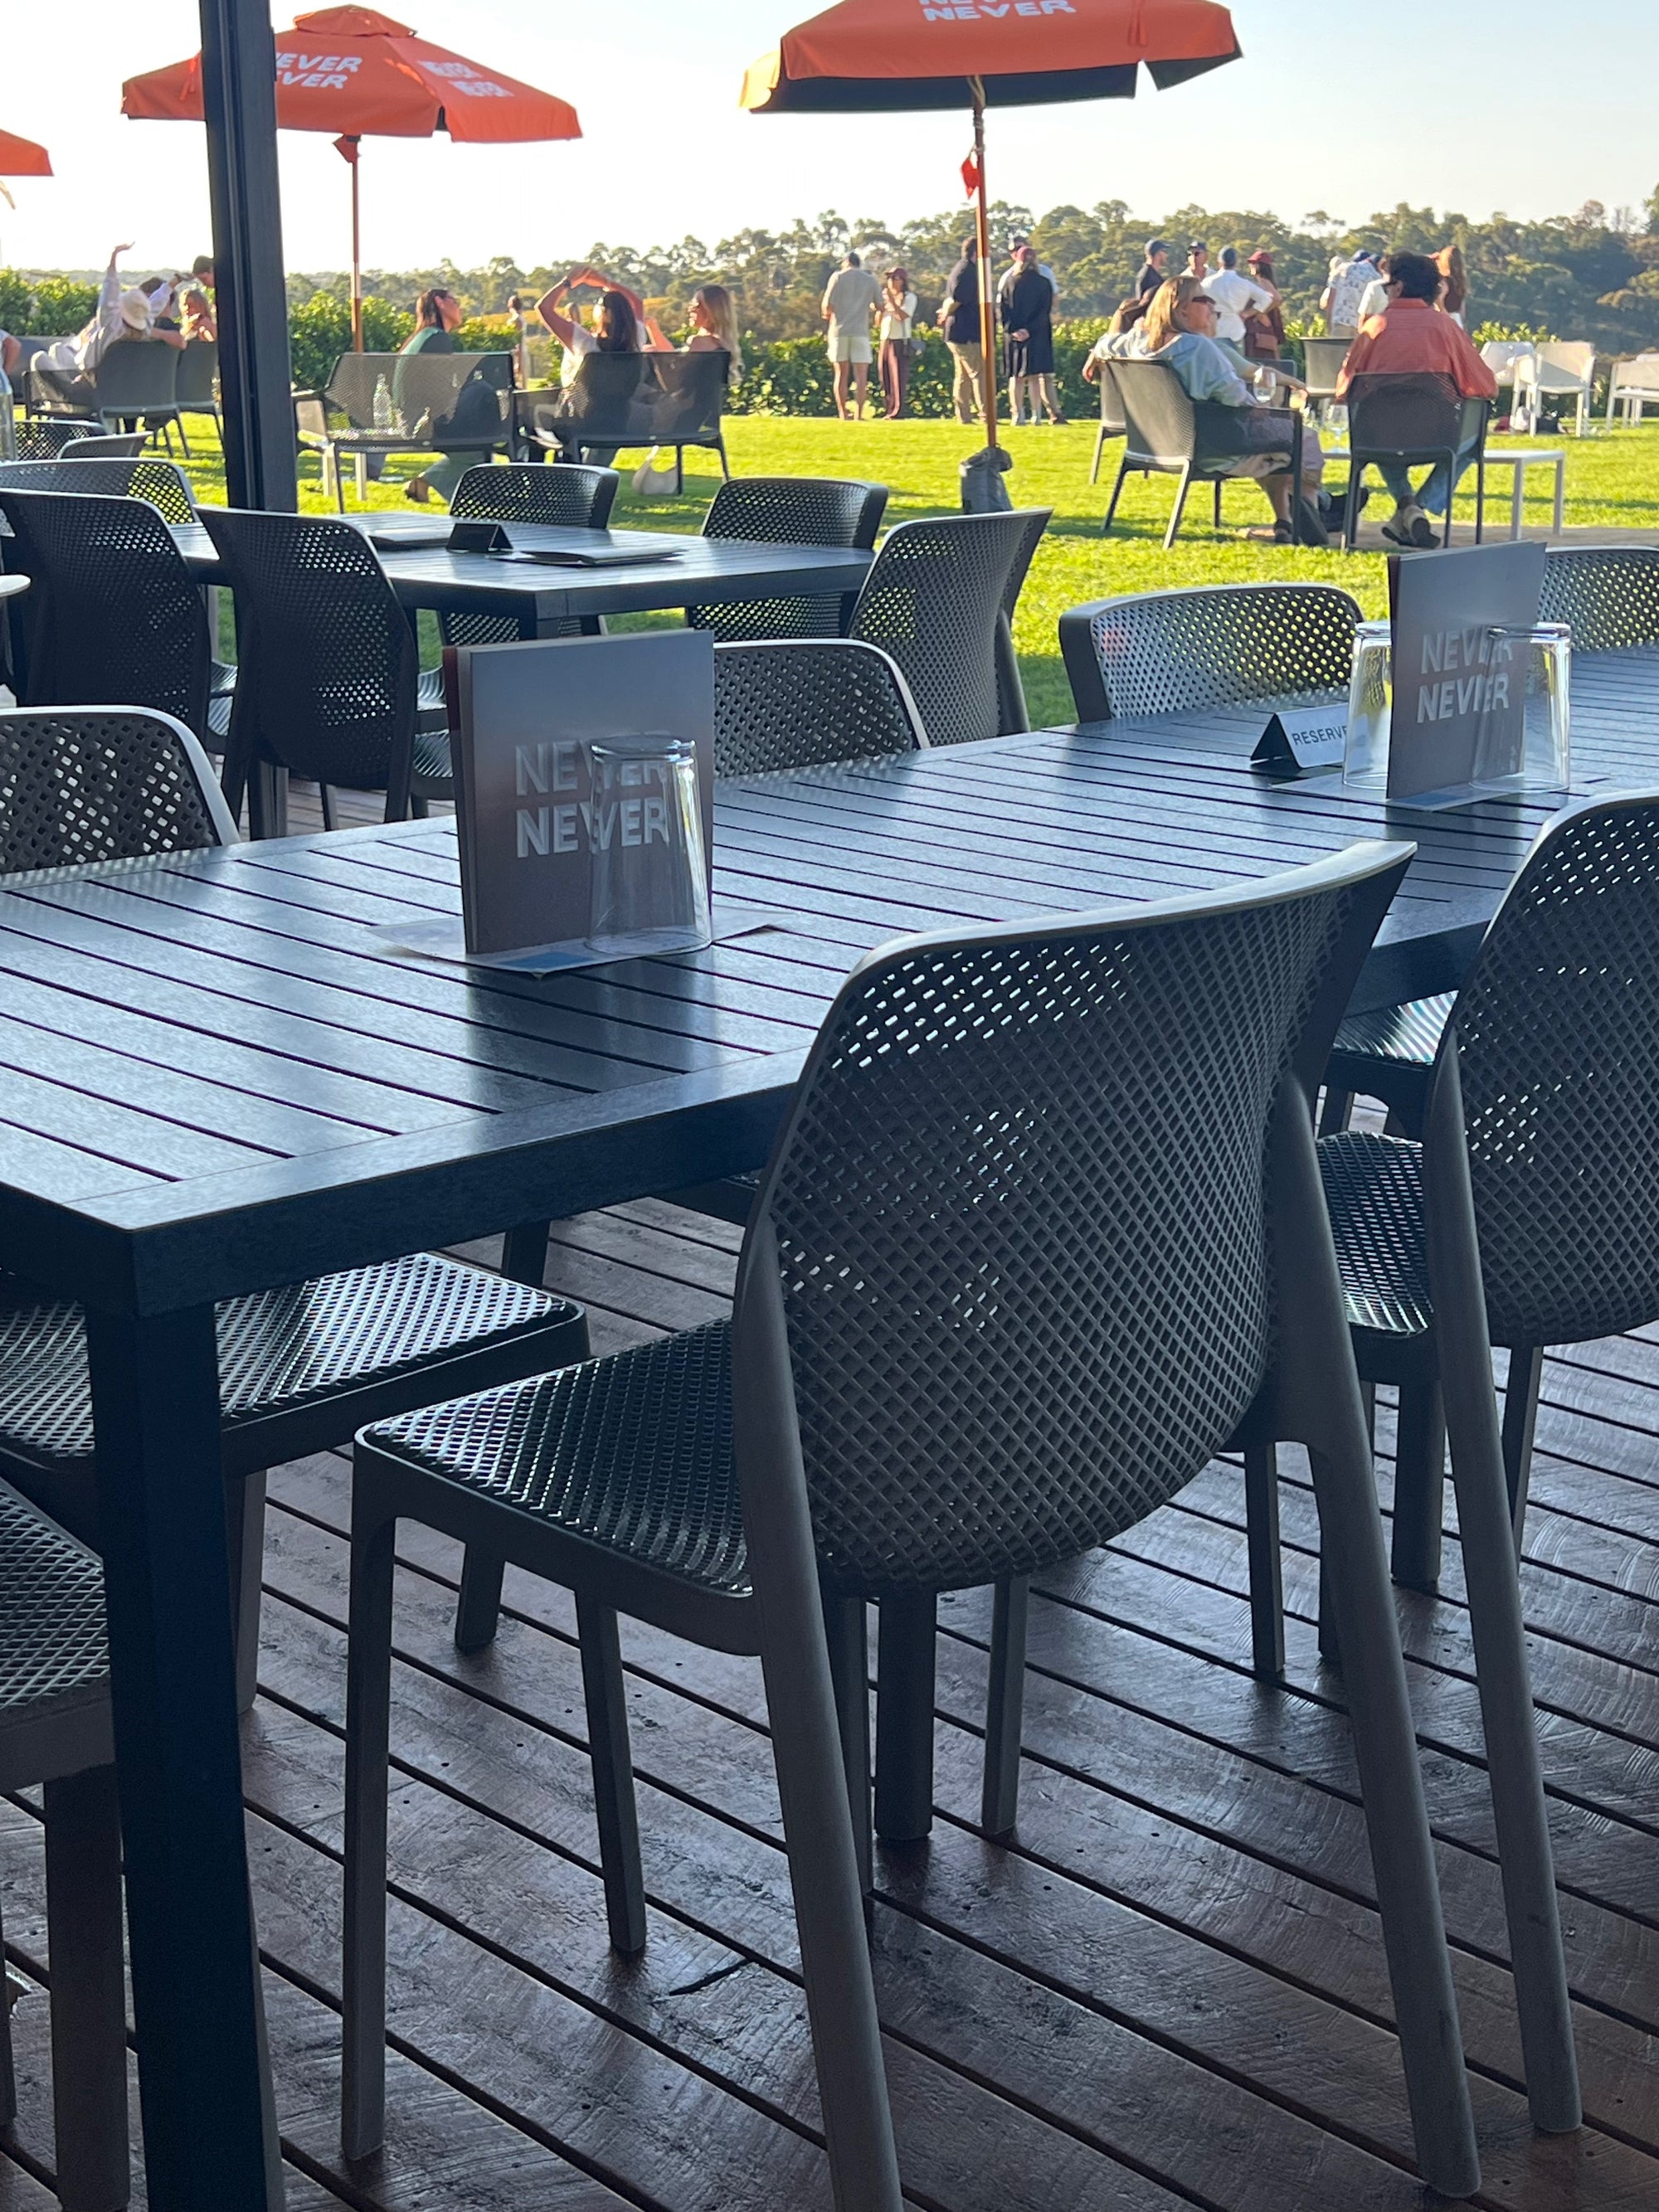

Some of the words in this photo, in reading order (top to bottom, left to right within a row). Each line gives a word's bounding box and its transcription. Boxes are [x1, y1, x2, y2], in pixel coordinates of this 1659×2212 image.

[922, 0, 1077, 22] NEVER
[276, 70, 348, 90] VER
[515, 796, 670, 858] NEVER
